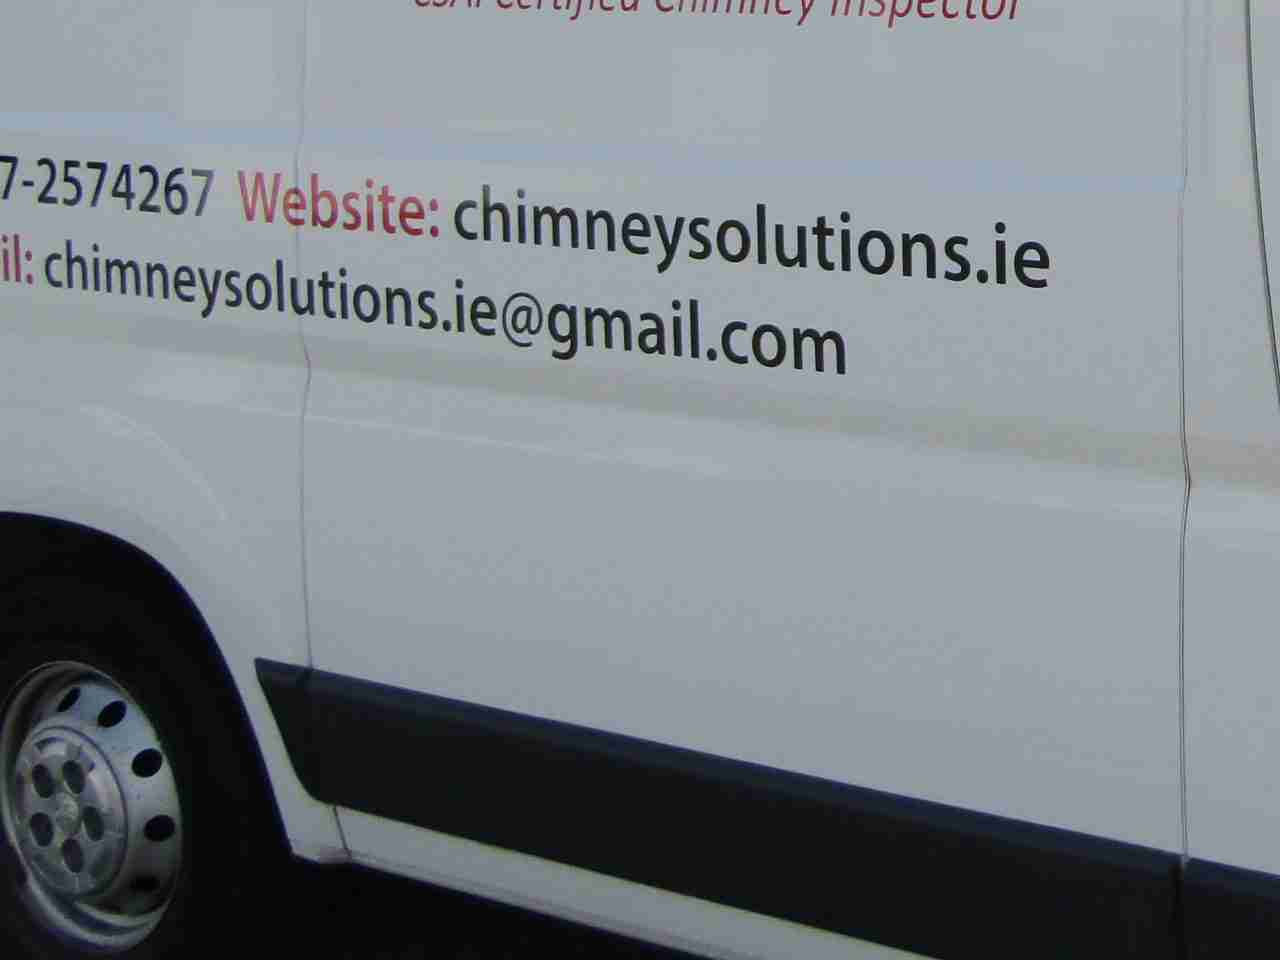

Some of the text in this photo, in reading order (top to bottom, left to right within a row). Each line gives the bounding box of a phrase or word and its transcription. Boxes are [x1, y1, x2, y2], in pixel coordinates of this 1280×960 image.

[0, 155, 1050, 290] 7-2574267 Website: chimneysolutions.ie
[44, 239, 846, 375] chimneysolutions.ie@gmail.com
